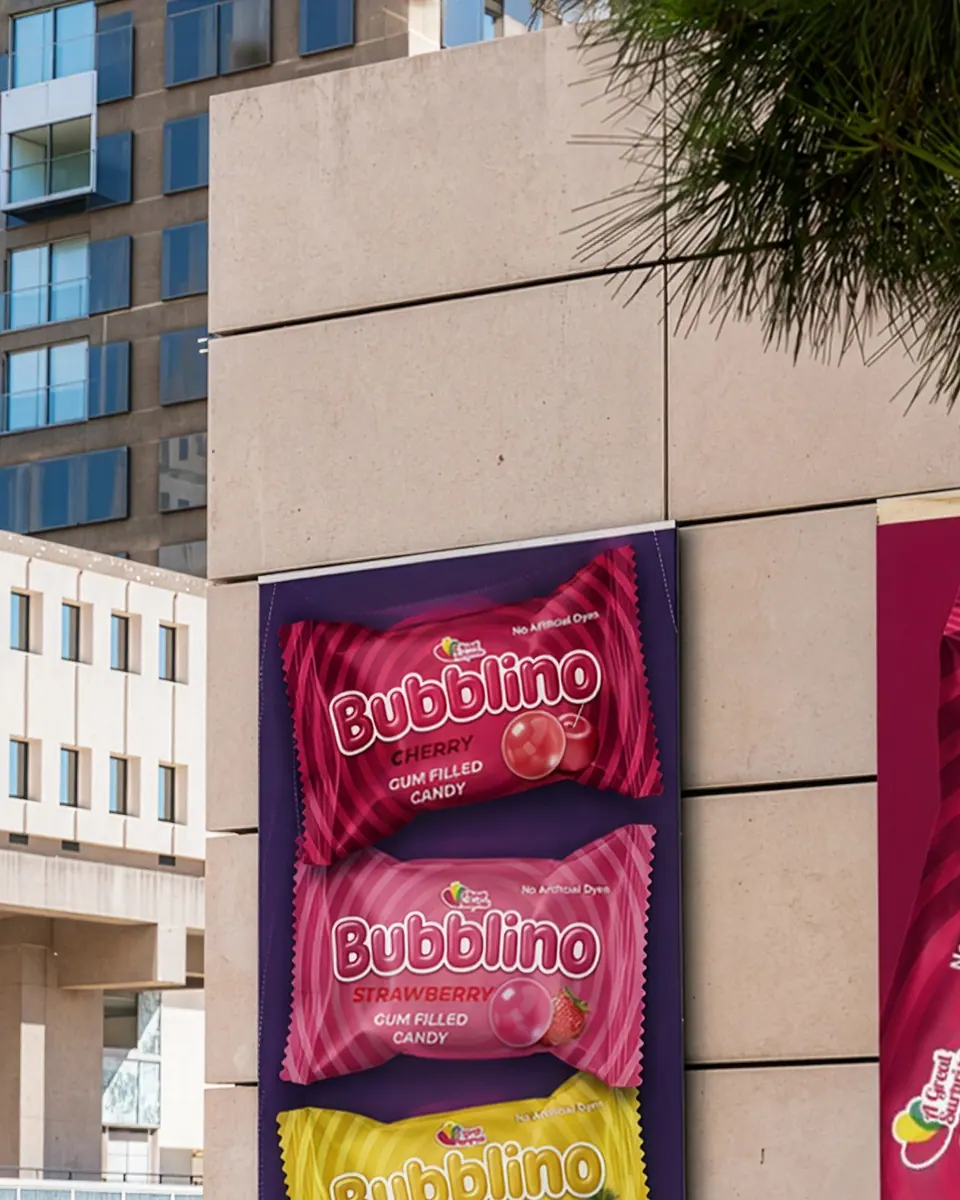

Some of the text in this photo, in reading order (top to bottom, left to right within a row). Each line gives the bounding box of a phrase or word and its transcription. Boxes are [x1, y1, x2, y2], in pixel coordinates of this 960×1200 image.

[512, 626, 528, 636] No
[329, 649, 602, 757] Bubblino
[390, 735, 474, 767] CHERRY
[388, 760, 484, 792] GUM FILLED
[410, 782, 467, 805] CANDY
[521, 884, 536, 895] No
[331, 909, 600, 983] Bubblino
[352, 985, 496, 1004] STRAWBERRY
[373, 1011, 468, 1028] GUM FILLED
[392, 1030, 449, 1046] CANDY
[925, 1055, 952, 1102] Great
